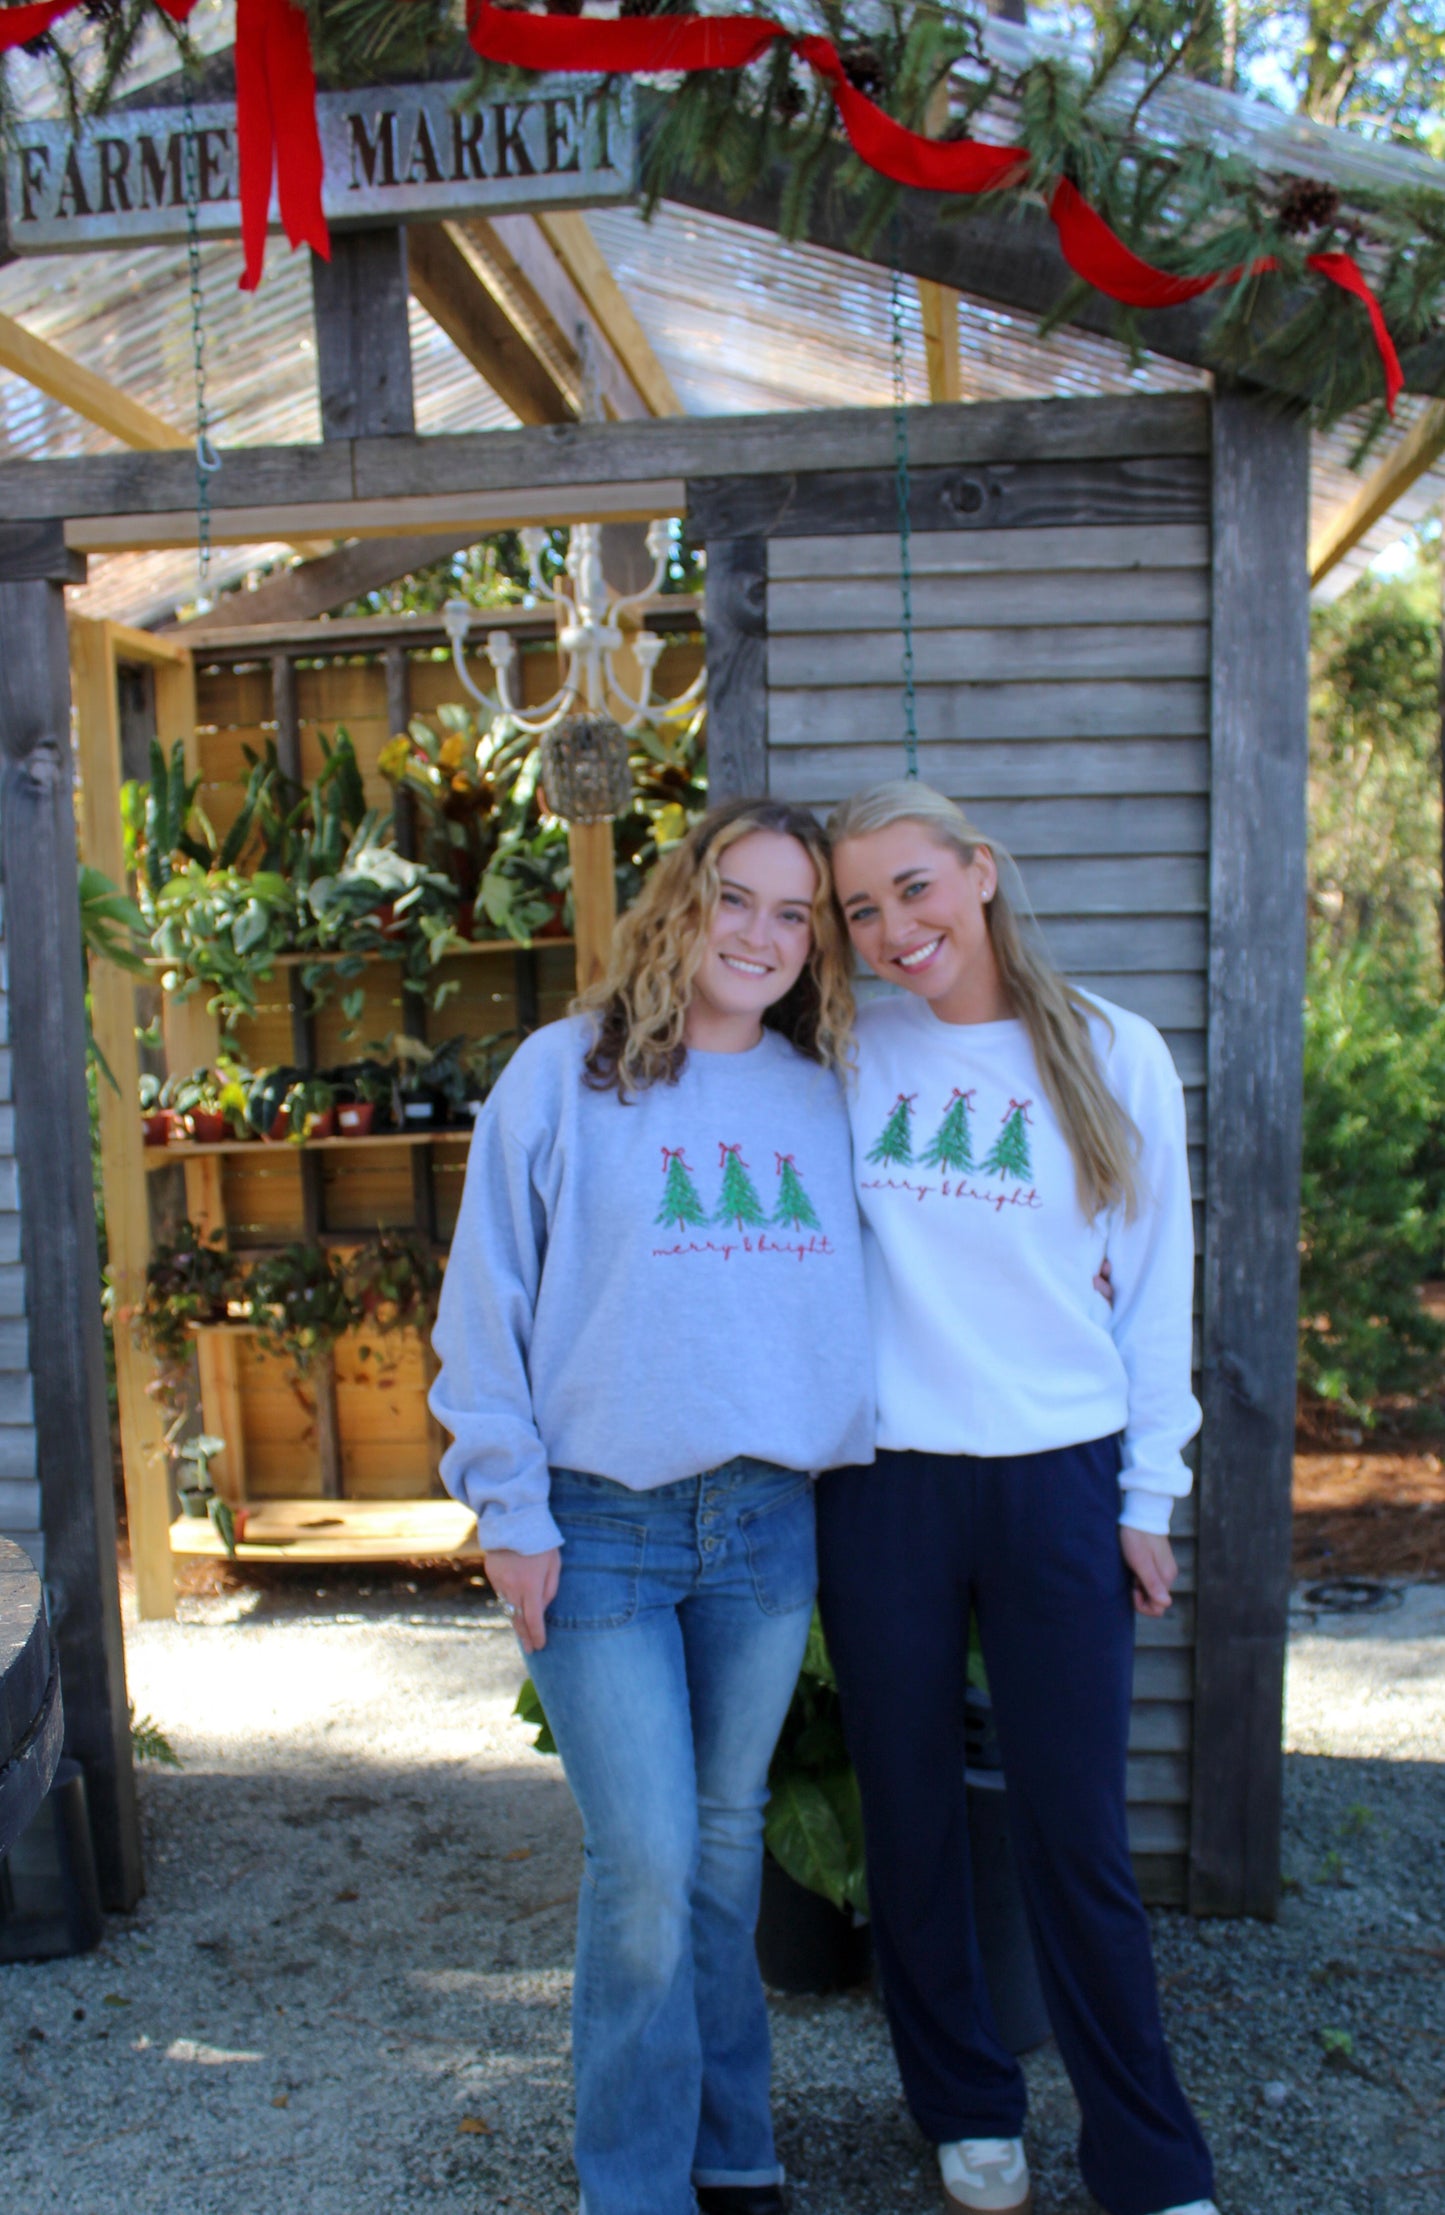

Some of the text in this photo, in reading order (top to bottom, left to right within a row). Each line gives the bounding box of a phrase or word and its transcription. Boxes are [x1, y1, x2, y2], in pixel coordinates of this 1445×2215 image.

[347, 94, 618, 190] MARKET
[955, 1180, 1043, 1212] bright
[653, 1241, 739, 1261] merry
[757, 1233, 834, 1262] bright
